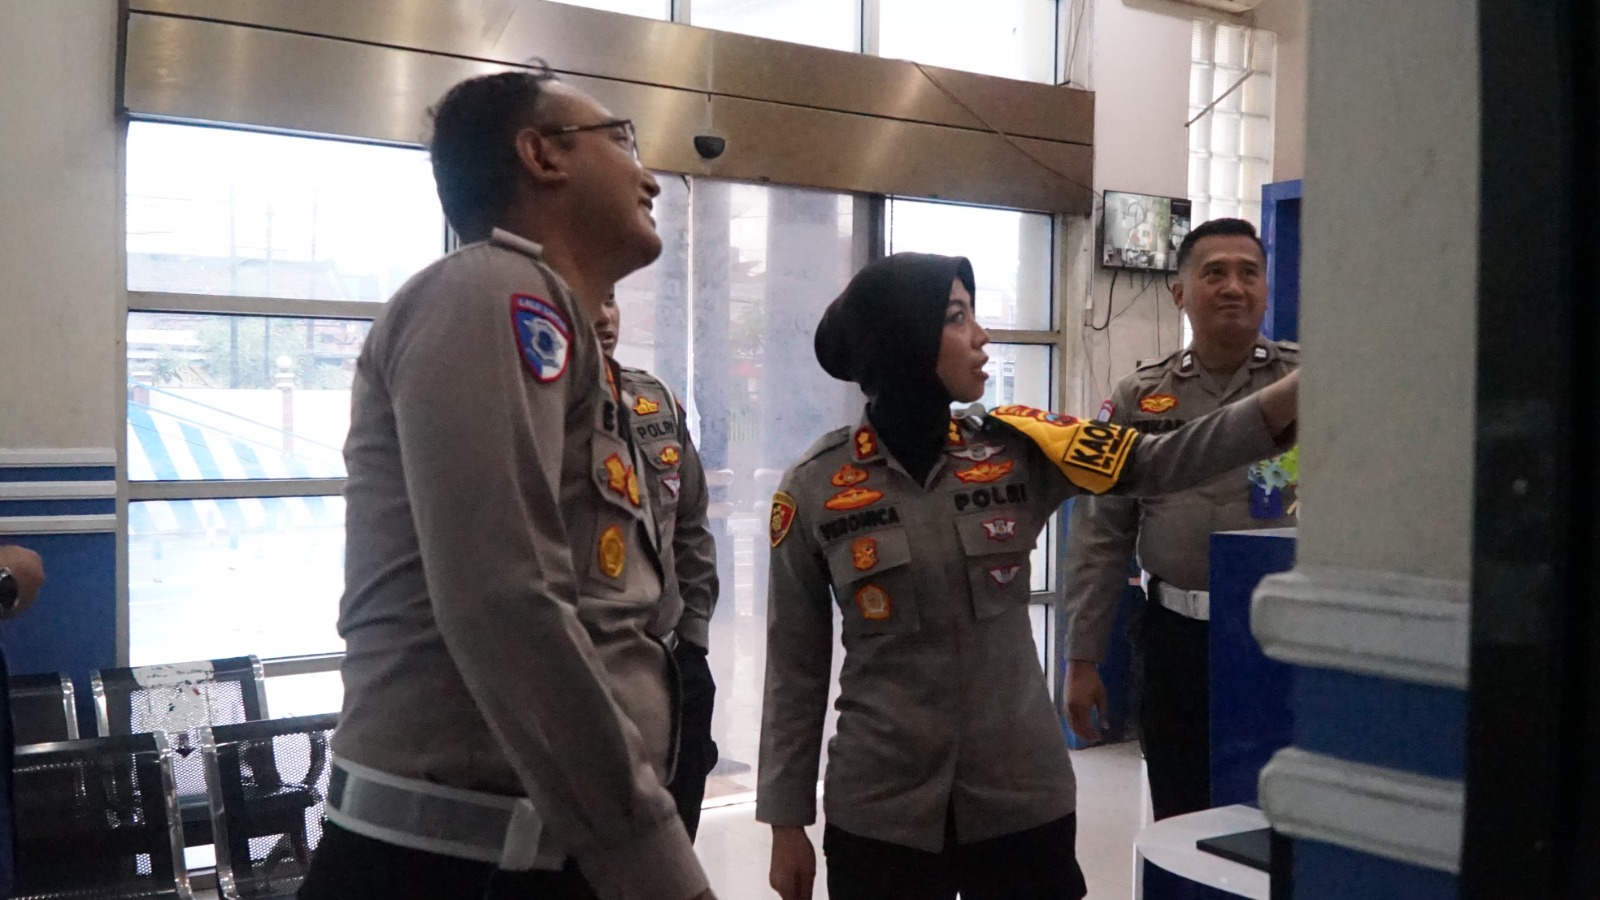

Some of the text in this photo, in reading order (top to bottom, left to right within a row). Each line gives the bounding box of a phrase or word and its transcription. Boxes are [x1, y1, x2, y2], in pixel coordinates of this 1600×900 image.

[637, 420, 675, 439] POLRI
[954, 483, 1026, 511] POLRI
[819, 506, 899, 541] VERONICA
